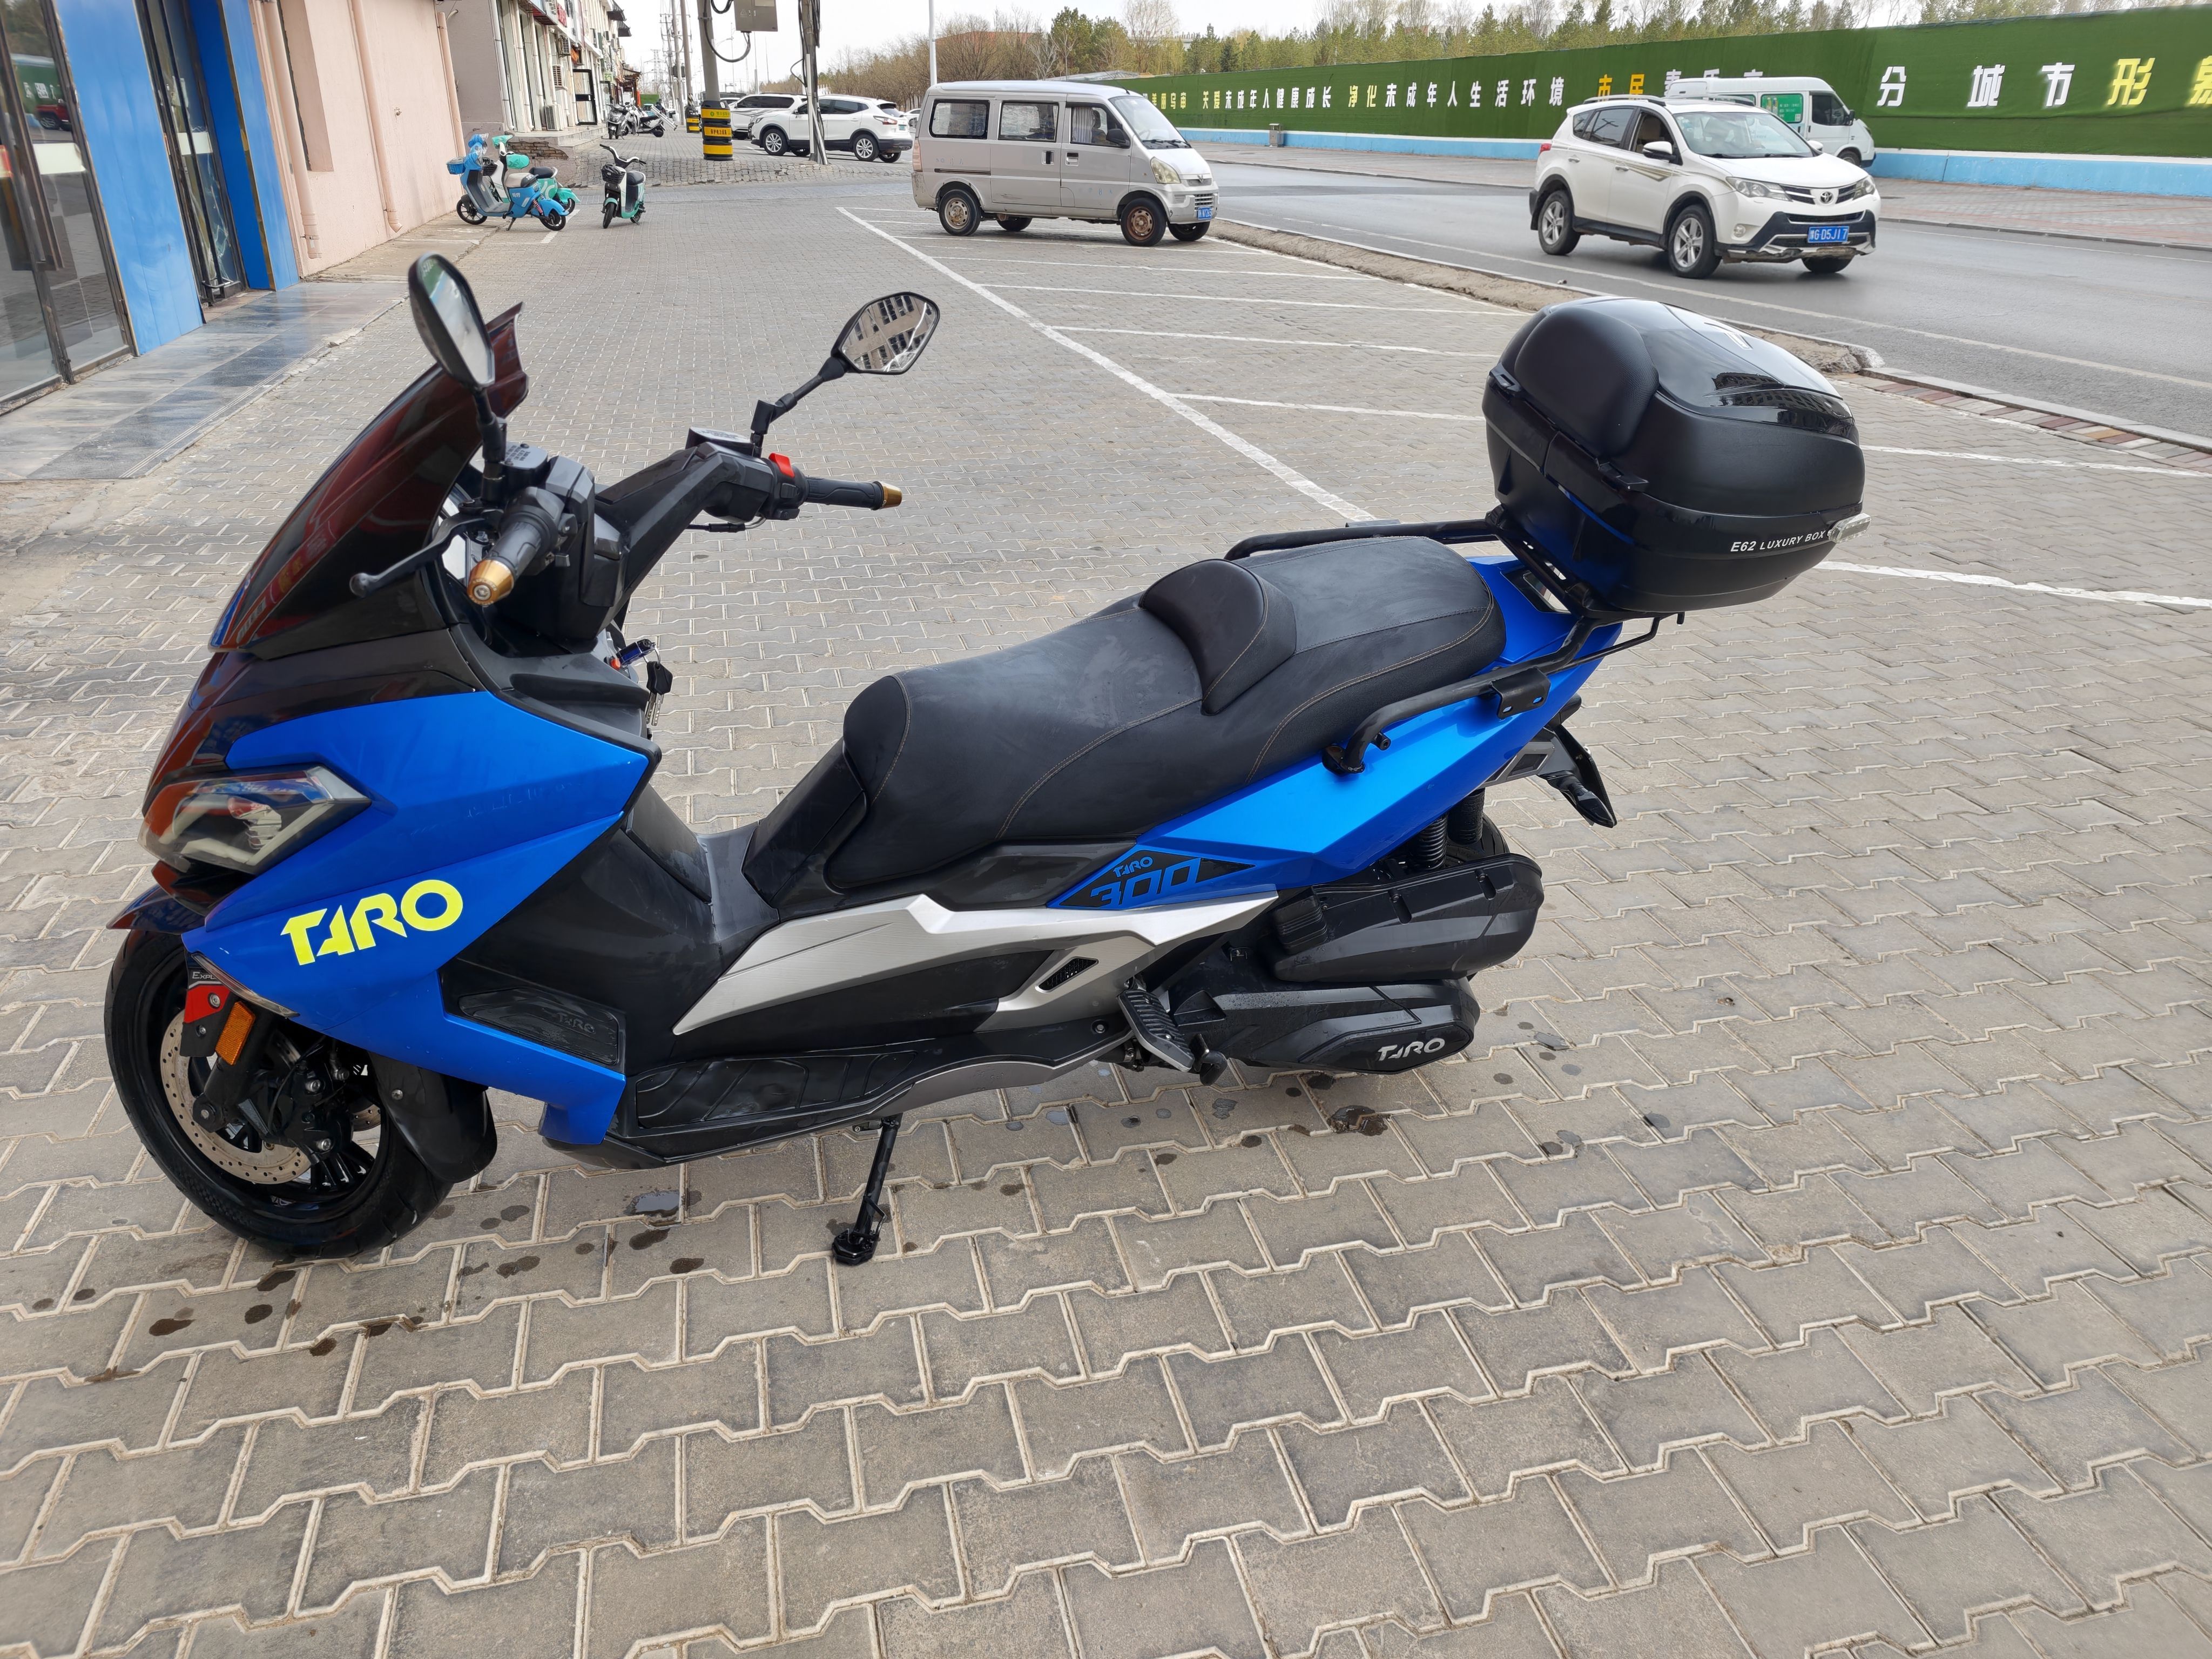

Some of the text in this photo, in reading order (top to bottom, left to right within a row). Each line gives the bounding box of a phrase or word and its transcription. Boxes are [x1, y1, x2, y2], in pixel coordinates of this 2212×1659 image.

[1203, 86, 1332, 109] 关爱未成年人健康成长
[1348, 76, 1564, 108] 净化未成年人生活环境
[1730, 530, 1826, 552] E62 LUXURY BOX
[1112, 856, 1154, 878] TARO
[1090, 857, 1202, 909] 300
[280, 879, 463, 966] TARO
[1378, 1037, 1445, 1061] TARO
